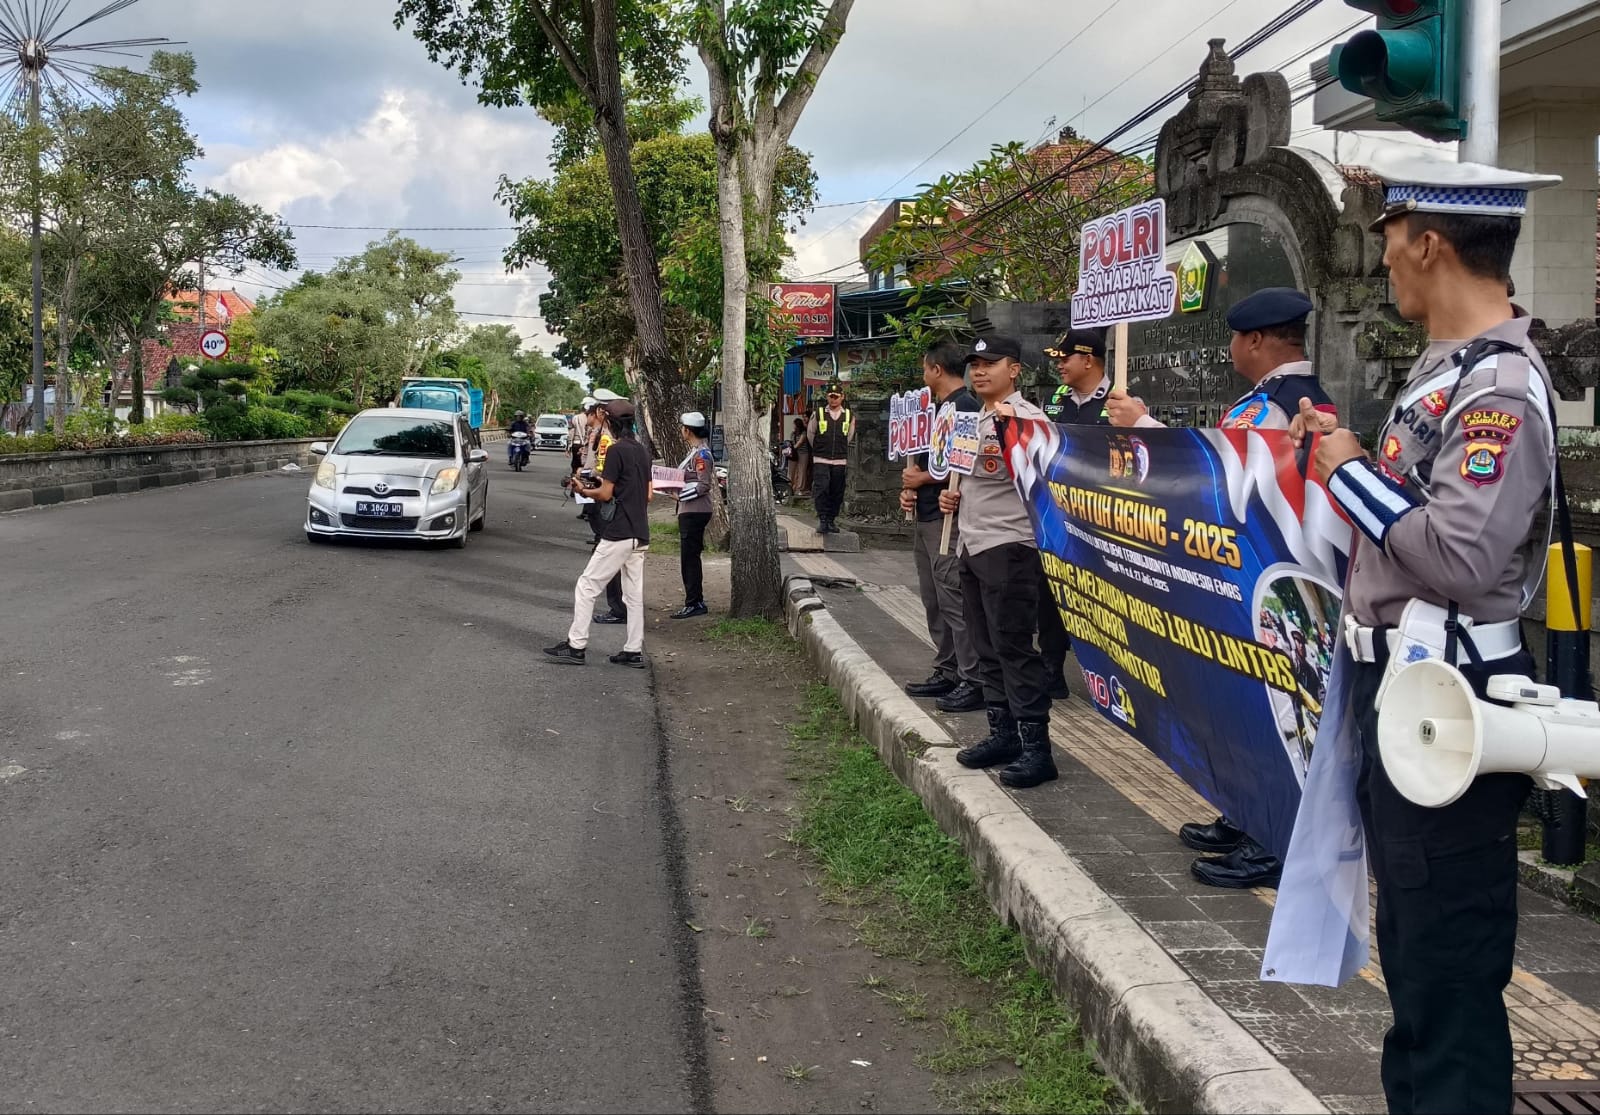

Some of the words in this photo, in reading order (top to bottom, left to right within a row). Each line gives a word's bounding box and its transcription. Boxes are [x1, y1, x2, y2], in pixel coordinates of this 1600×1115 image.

[1082, 208, 1160, 272] POLRI
[1087, 261, 1154, 298] SAHABAT
[811, 313, 829, 324] SPA
[1073, 282, 1172, 321] MASYARAKAT
[204, 340, 217, 350] 40
[890, 410, 933, 454] POLRI
[1464, 411, 1518, 426] POLRES
[1469, 430, 1506, 440] BALI
[1069, 487, 1113, 530] PATUH
[1113, 498, 1168, 548] AGUNG
[1183, 518, 1243, 569] 2025
[1213, 578, 1243, 602] EMAS
[1127, 593, 1167, 638] ARUS
[1164, 611, 1214, 660] LALU
[1210, 630, 1297, 692] LINTAS
